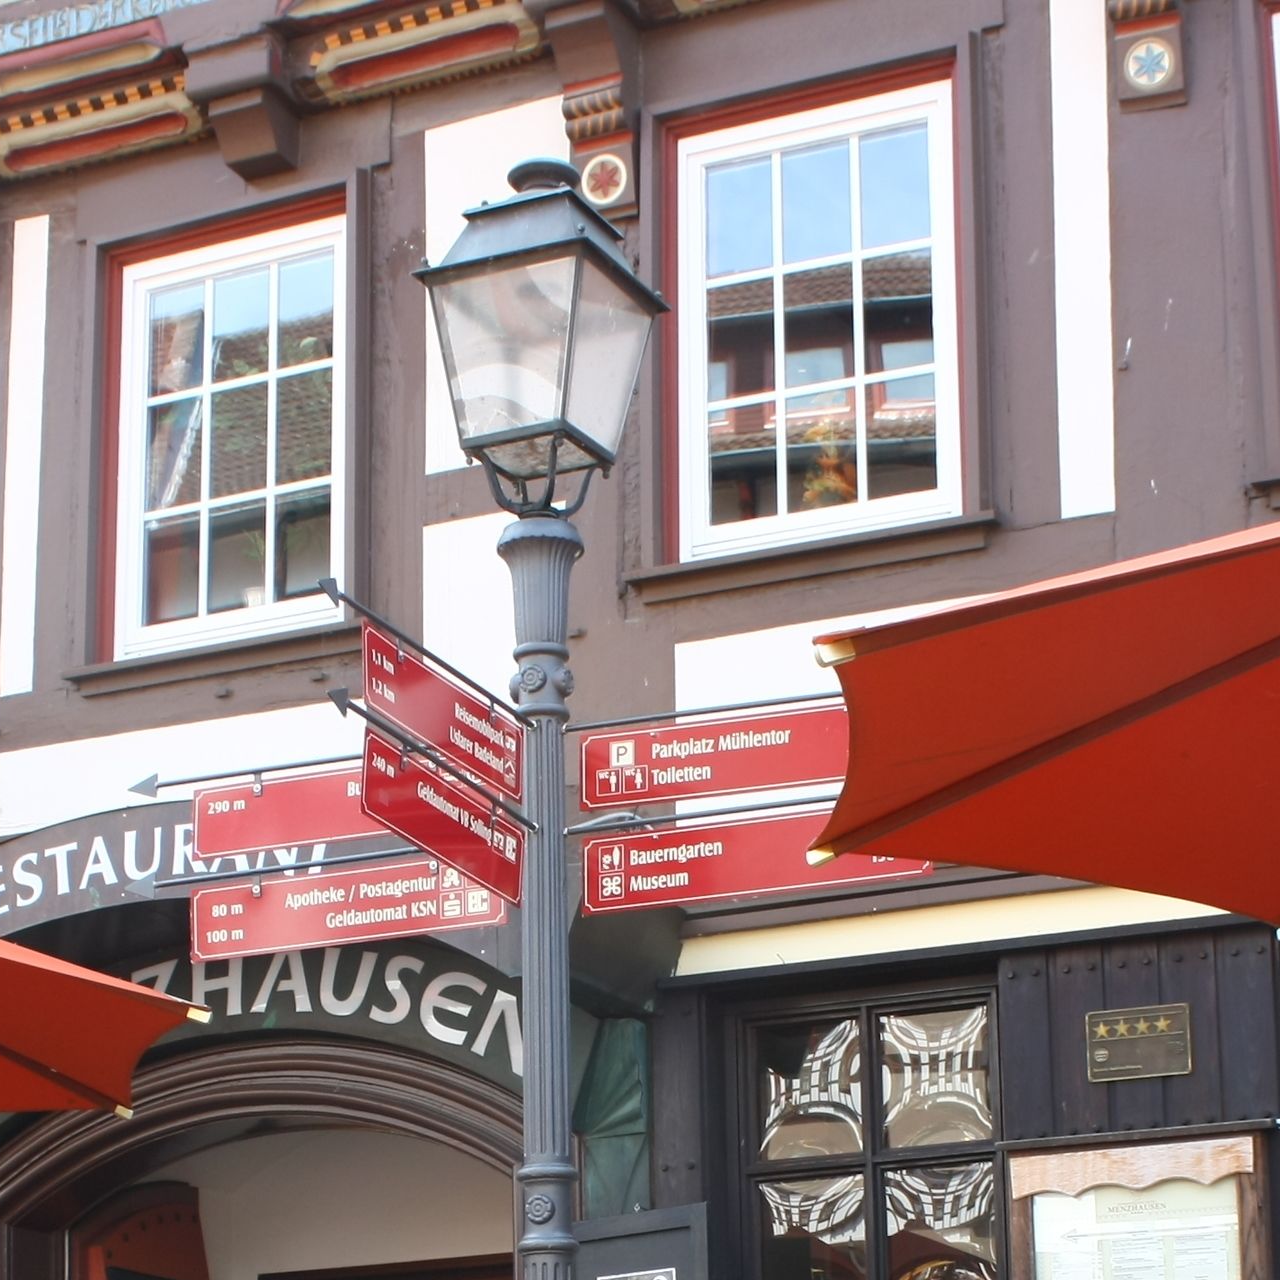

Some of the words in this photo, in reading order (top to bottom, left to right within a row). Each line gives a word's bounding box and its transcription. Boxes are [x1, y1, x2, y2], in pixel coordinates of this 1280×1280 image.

[383, 655, 395, 675] km
[383, 683, 396, 704] km
[651, 738, 714, 760] Parkplatz
[718, 728, 791, 752] Mühlentor
[371, 752, 386, 773] 240
[386, 764, 395, 779] m
[651, 766, 711, 786] Toiletten
[207, 800, 230, 815] 290
[233, 799, 245, 811] m
[417, 781, 460, 823] Geldautomat
[460, 808, 470, 828] VB
[470, 814, 493, 847] Solling
[630, 841, 723, 866] Bauerngarten
[630, 872, 689, 892] Museum
[211, 904, 227, 918] 80
[231, 903, 243, 915] m
[285, 887, 345, 911] Apotheke
[359, 875, 437, 901] Postagentur
[205, 929, 228, 944] 100
[231, 928, 244, 940] m
[326, 905, 408, 929] Geldautomat
[411, 899, 437, 918] KSN
